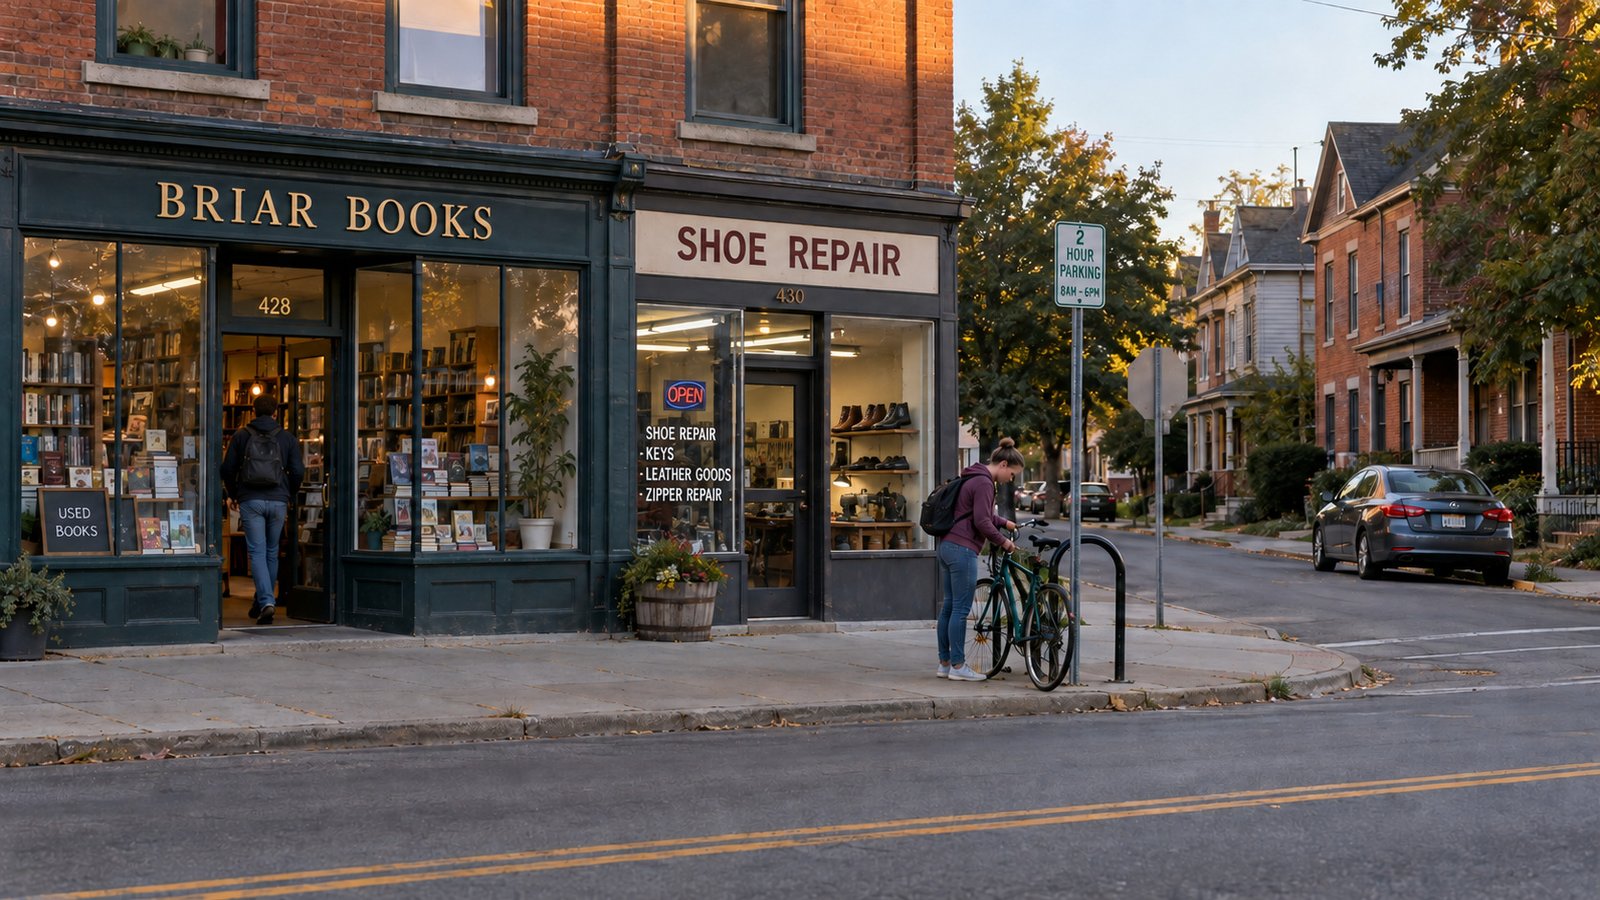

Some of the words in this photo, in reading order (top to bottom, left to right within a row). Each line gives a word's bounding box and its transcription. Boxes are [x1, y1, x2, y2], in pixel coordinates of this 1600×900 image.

[156, 181, 318, 229] BRIAR
[346, 195, 493, 241] BOOKS
[1076, 230, 1084, 245] 2
[677, 225, 767, 266] SHOE
[789, 235, 901, 276] REPAIR
[1067, 248, 1094, 262] HOUR
[1060, 264, 1101, 280] PARKING
[776, 287, 805, 304] 430
[1060, 285, 1077, 297] 8AM
[1084, 286, 1100, 298] 6PM
[258, 296, 292, 316] 428
[667, 386, 704, 403] OPEN
[645, 426, 676, 440] SHOE
[679, 427, 717, 441] REPAIR
[645, 446, 675, 461] KEYS
[645, 467, 692, 481] LEATHER
[695, 467, 732, 482] GOODS
[645, 487, 683, 501] ZIPPER
[686, 488, 723, 501] REPAIR
[58, 507, 91, 519] USED
[55, 525, 98, 537] BOOKS
